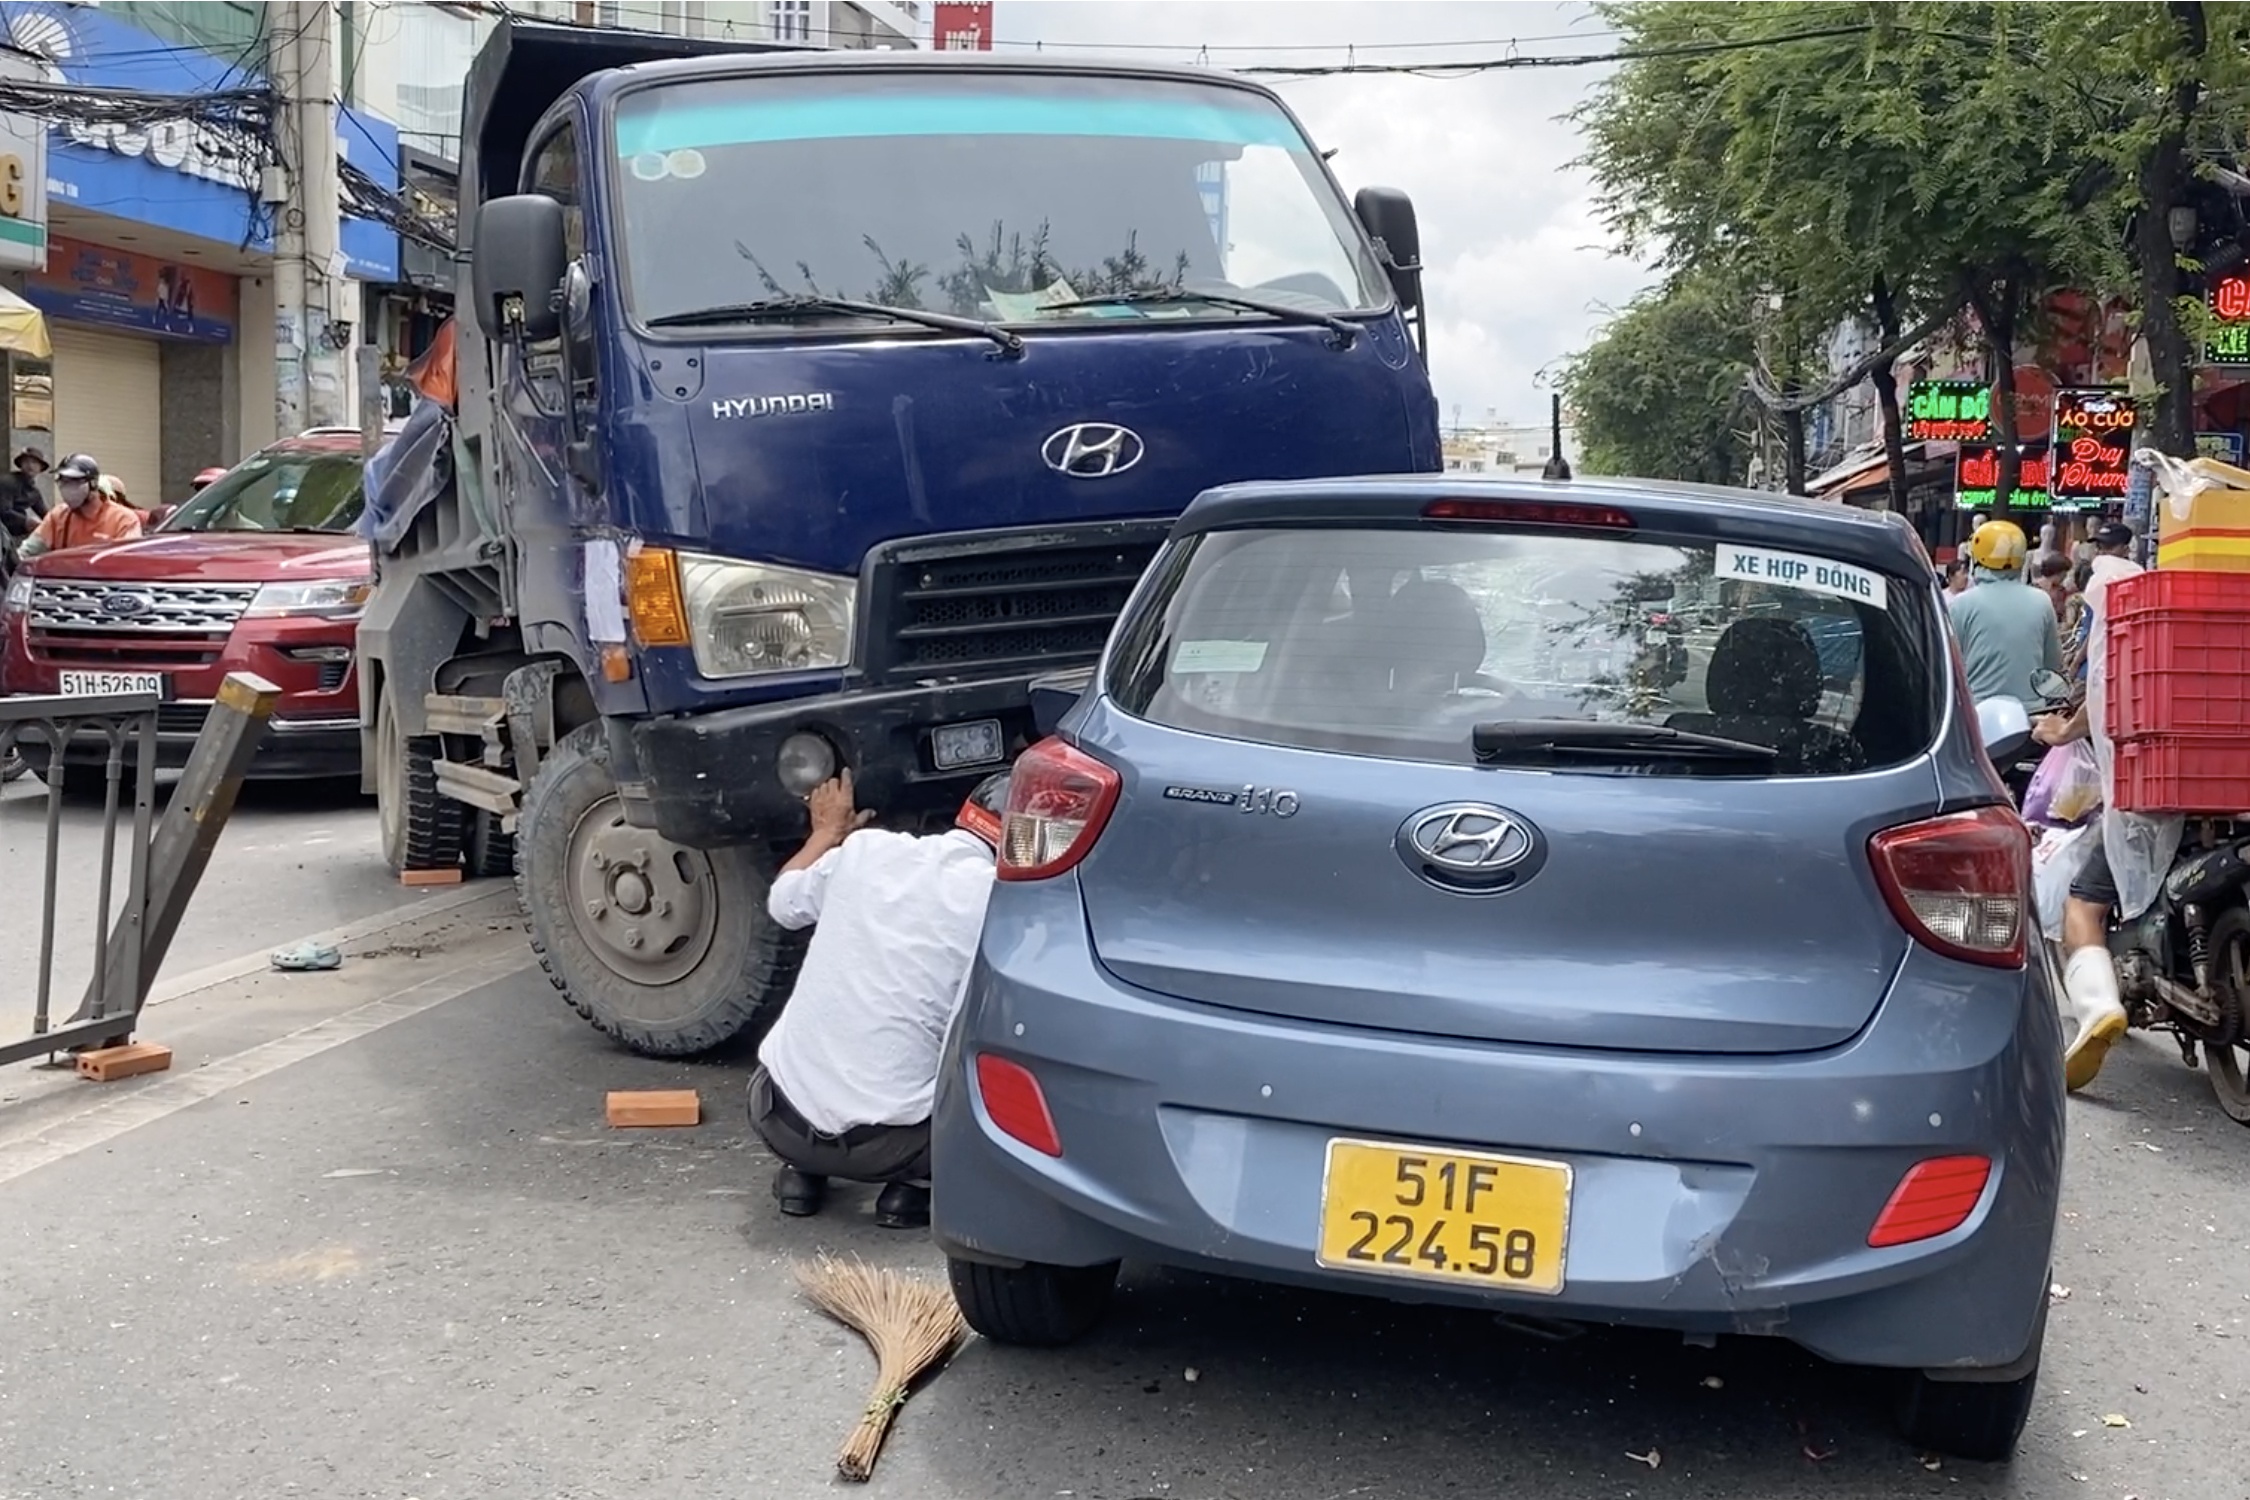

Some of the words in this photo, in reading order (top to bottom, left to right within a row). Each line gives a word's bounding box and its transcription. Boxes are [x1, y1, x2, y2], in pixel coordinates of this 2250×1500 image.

[712, 393, 834, 419] HYUNDAI
[2061, 409, 2088, 426] ÁO
[2093, 410, 2134, 426] CƯỚ
[2072, 437, 2124, 467] Duy
[1733, 554, 1759, 574] XE
[1767, 559, 1808, 583] HỢP
[1816, 564, 1871, 597] ĐỒNG
[1166, 787, 1233, 803] GRAND
[1240, 784, 1299, 818] i10
[1395, 1157, 1498, 1213] 51F
[1347, 1211, 1536, 1279] 224.58
